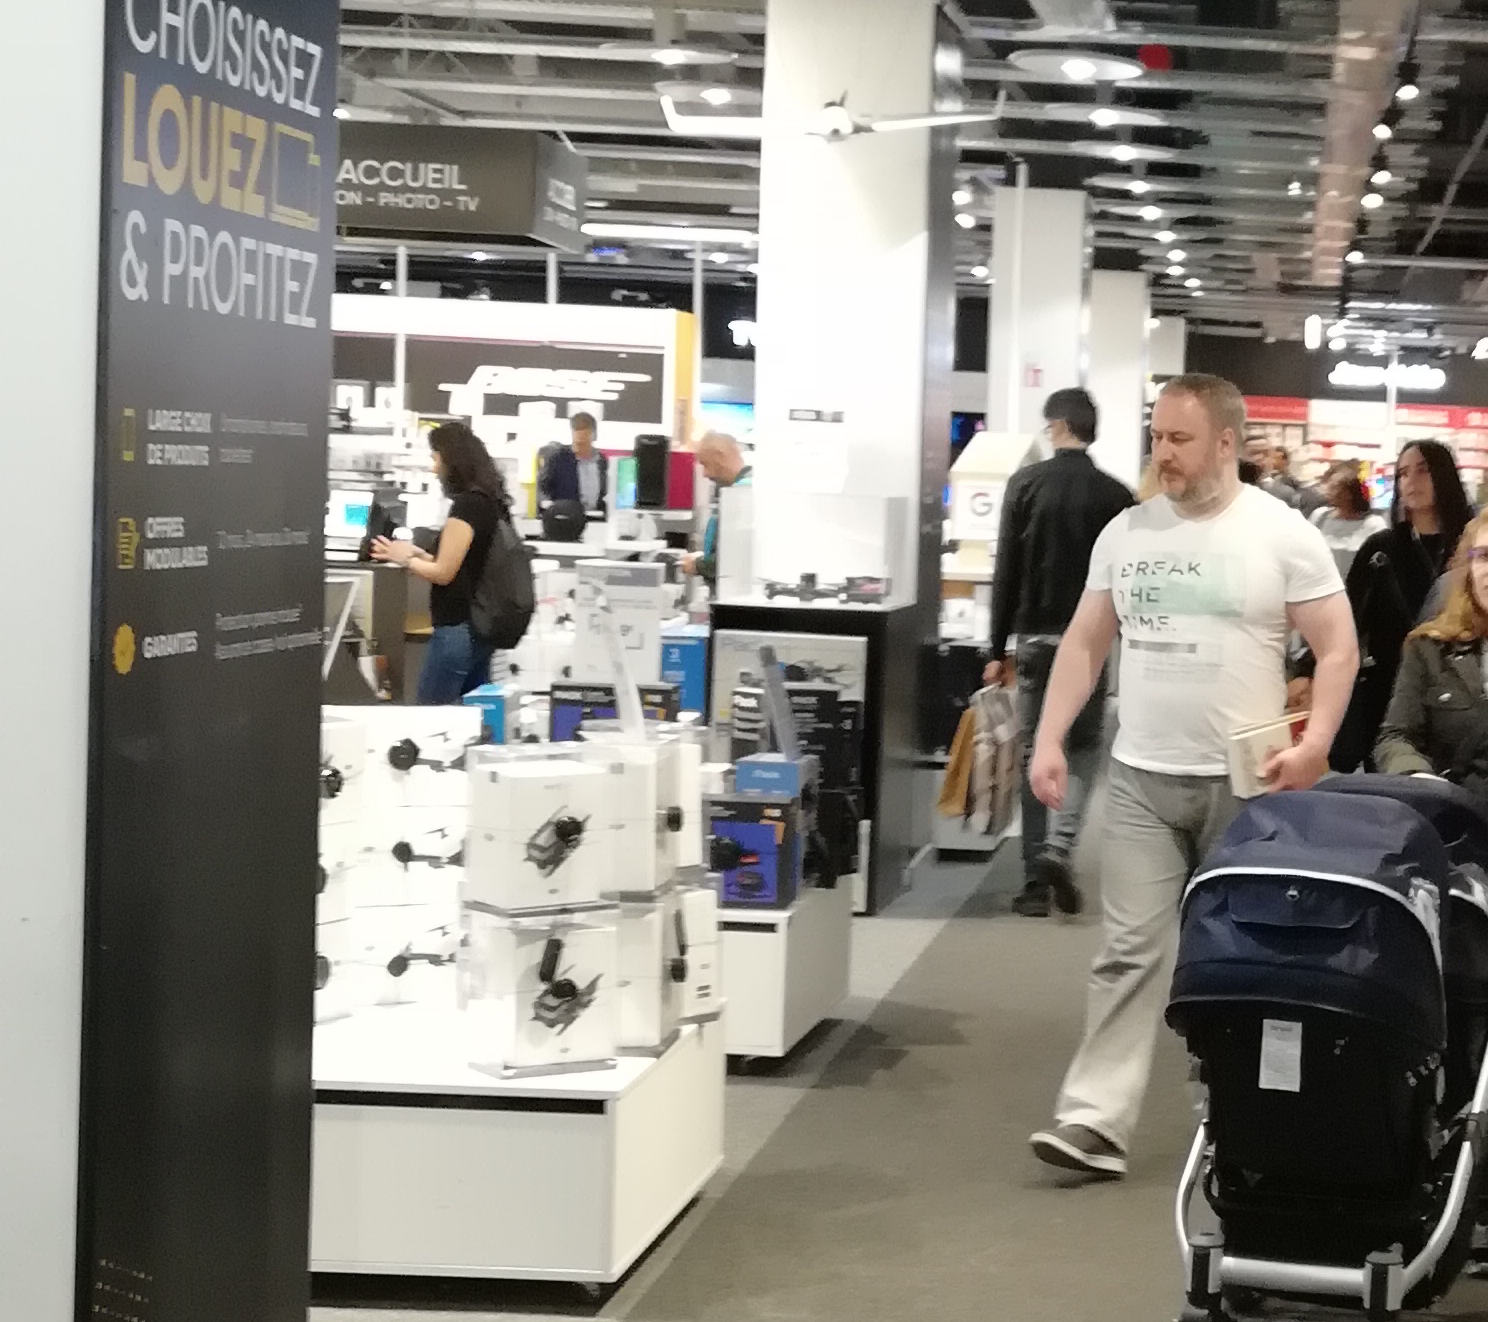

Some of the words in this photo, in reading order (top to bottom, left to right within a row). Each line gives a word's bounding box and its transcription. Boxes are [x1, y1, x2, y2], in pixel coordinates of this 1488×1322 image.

[121, 71, 268, 219] LOUEZ
[335, 158, 469, 190] ACCUEIL
[378, 192, 440, 210] PHOTO
[456, 195, 481, 212] TV
[119, 209, 151, 302] &
[162, 218, 318, 329] PROFITEZ
